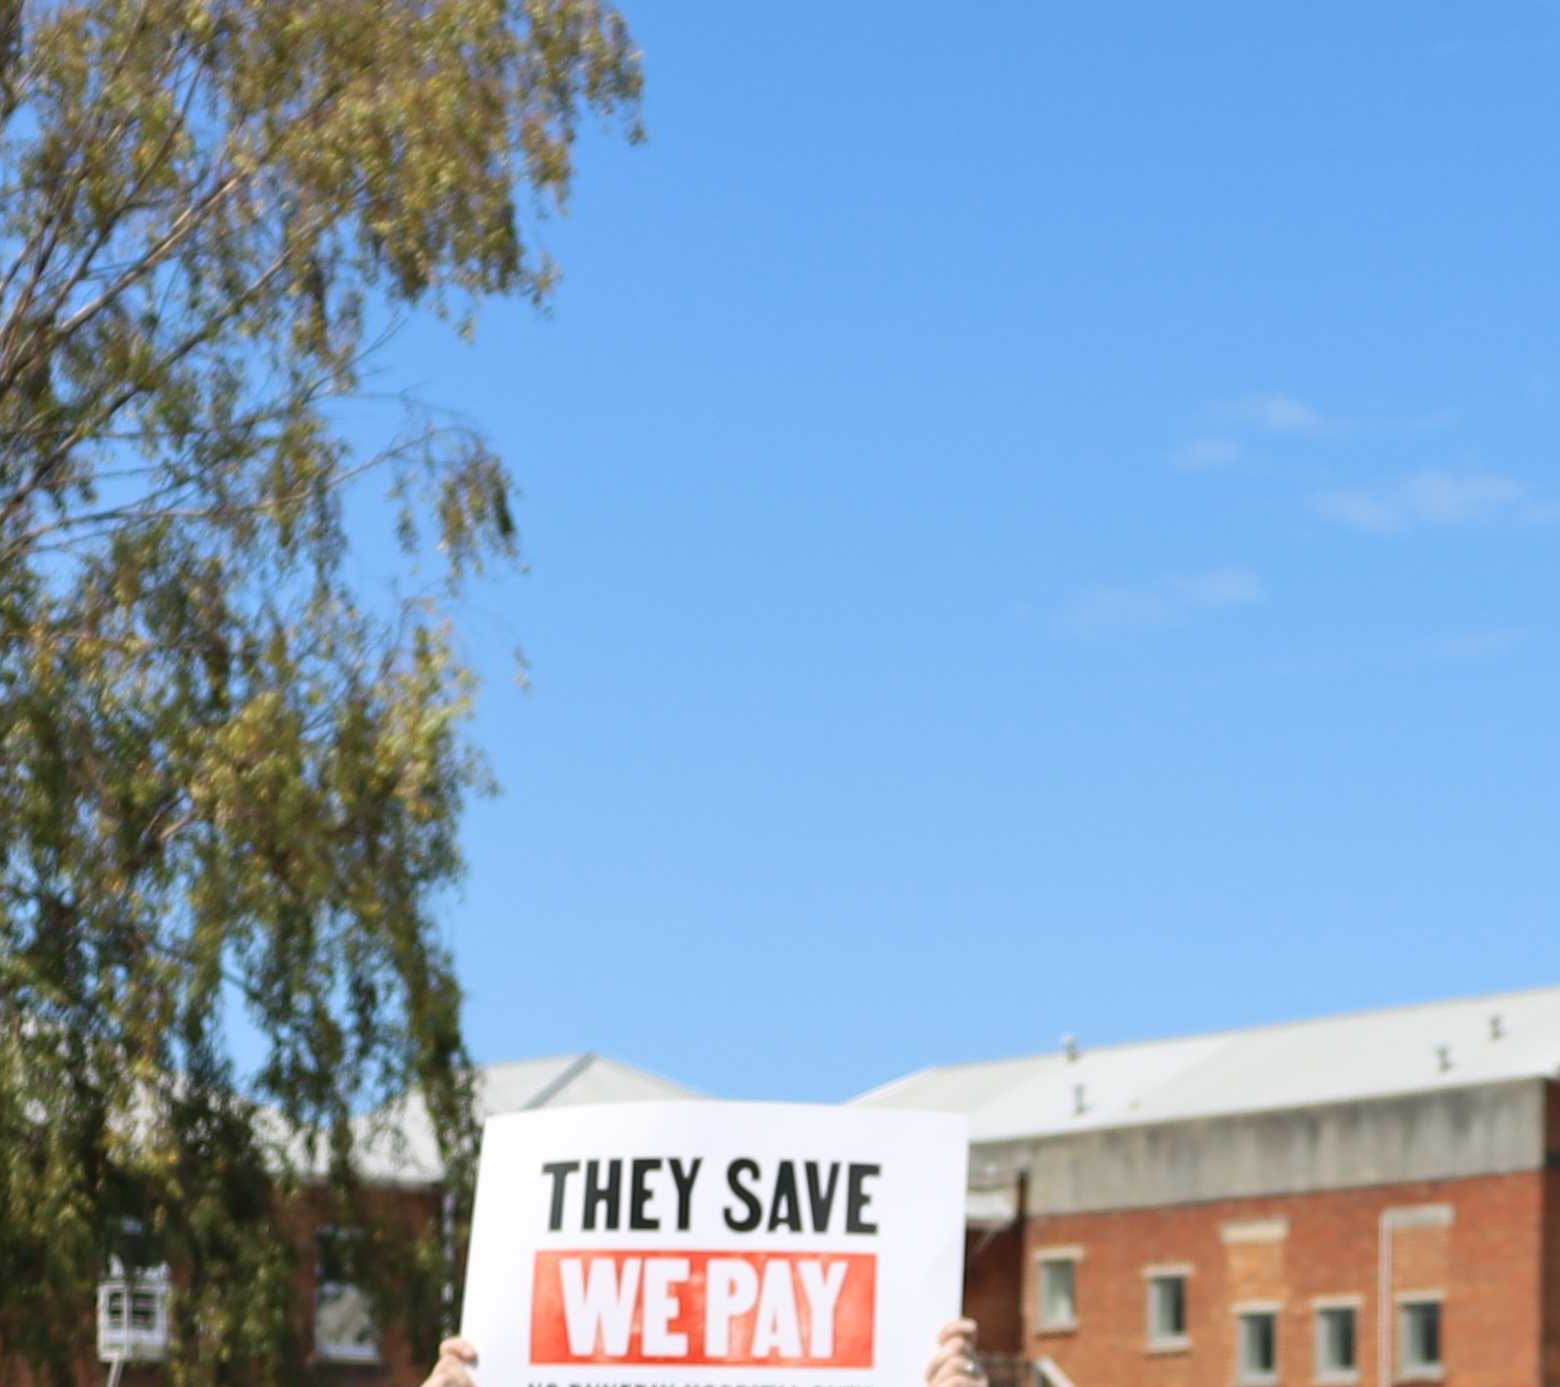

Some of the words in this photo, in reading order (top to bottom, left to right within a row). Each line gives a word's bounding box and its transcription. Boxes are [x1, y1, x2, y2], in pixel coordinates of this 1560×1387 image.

[541, 1157, 703, 1231] THEY
[723, 1157, 882, 1235] SAVE
[558, 1256, 691, 1358] WE
[704, 1258, 849, 1360] PAY
